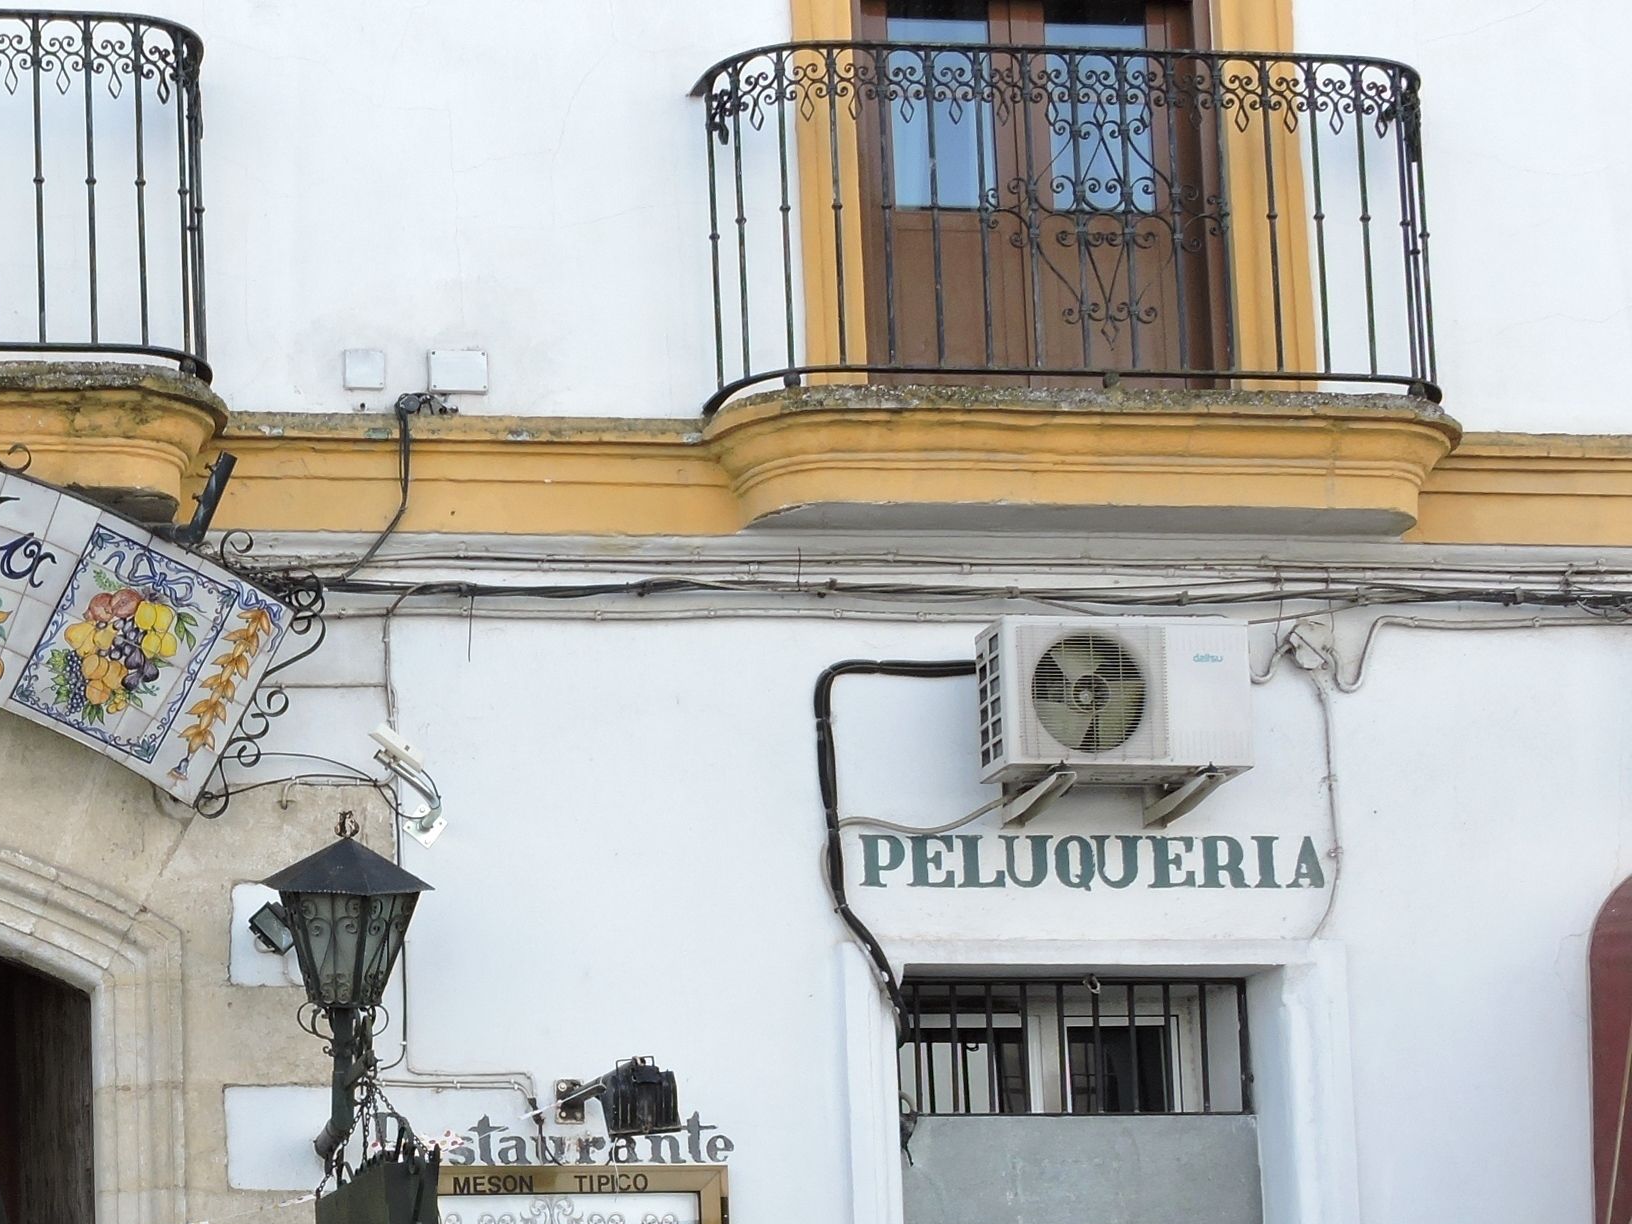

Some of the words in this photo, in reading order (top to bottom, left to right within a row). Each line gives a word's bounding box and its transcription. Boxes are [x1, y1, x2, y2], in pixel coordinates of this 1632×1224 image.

[858, 834, 1326, 891] PELUQUERIA
[453, 1175, 534, 1193] MESON
[574, 1174, 649, 1193] TIPICO
